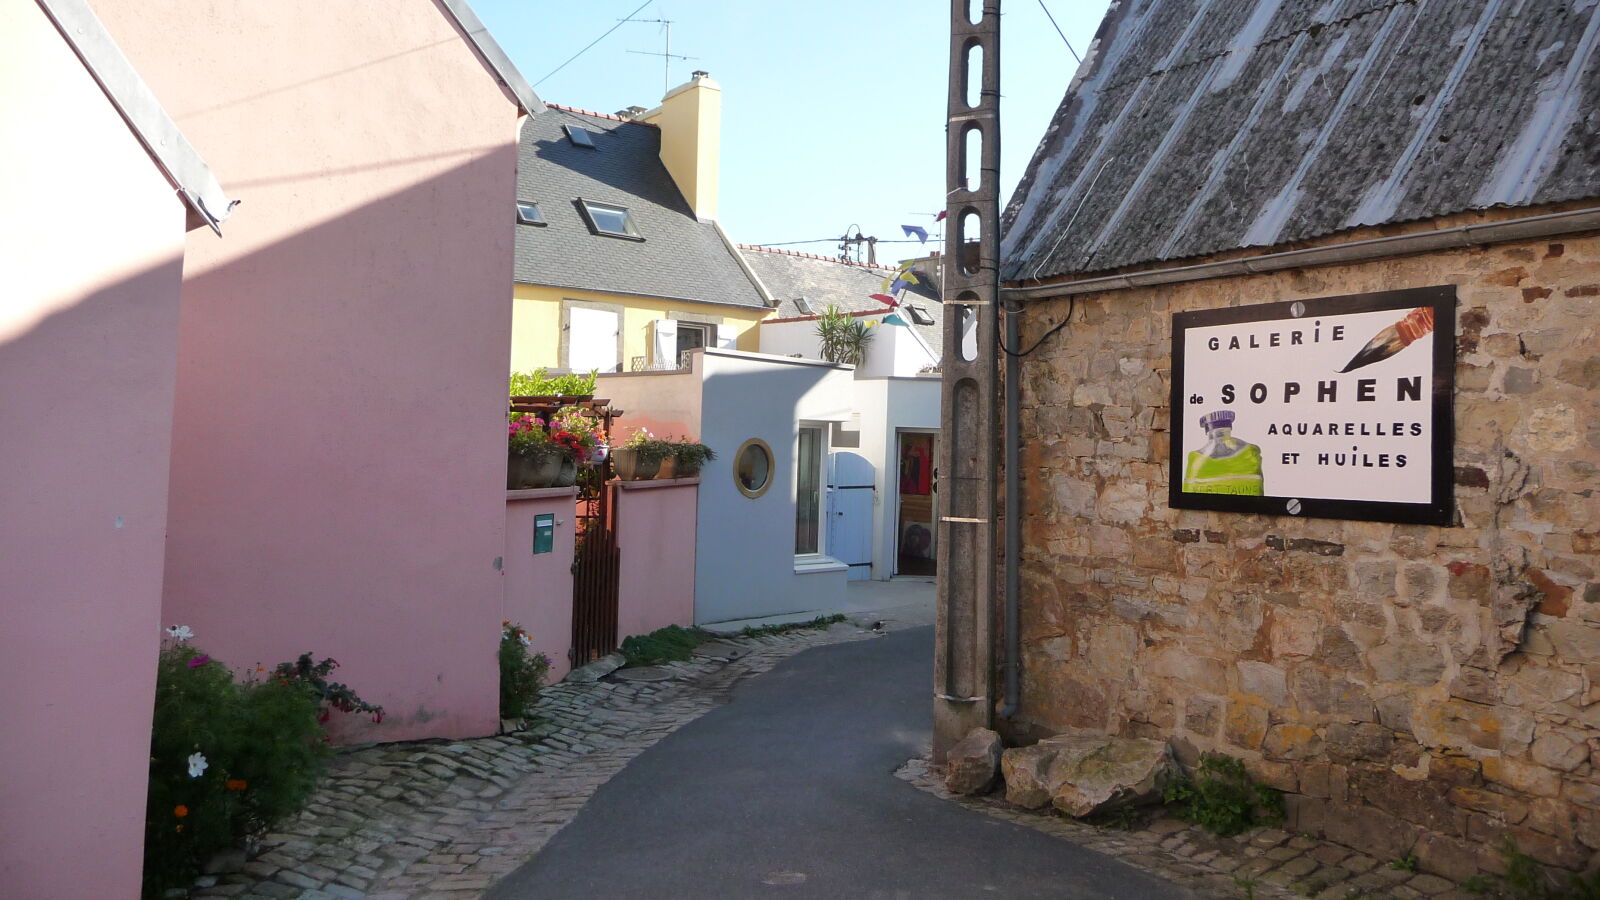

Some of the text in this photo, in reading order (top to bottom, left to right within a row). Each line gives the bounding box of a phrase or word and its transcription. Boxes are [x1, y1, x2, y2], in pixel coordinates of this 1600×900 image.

[1189, 376, 1422, 405] de SOPHEN
[1267, 422, 1422, 436] AQUARELLES
[1281, 452, 1300, 465] ET
